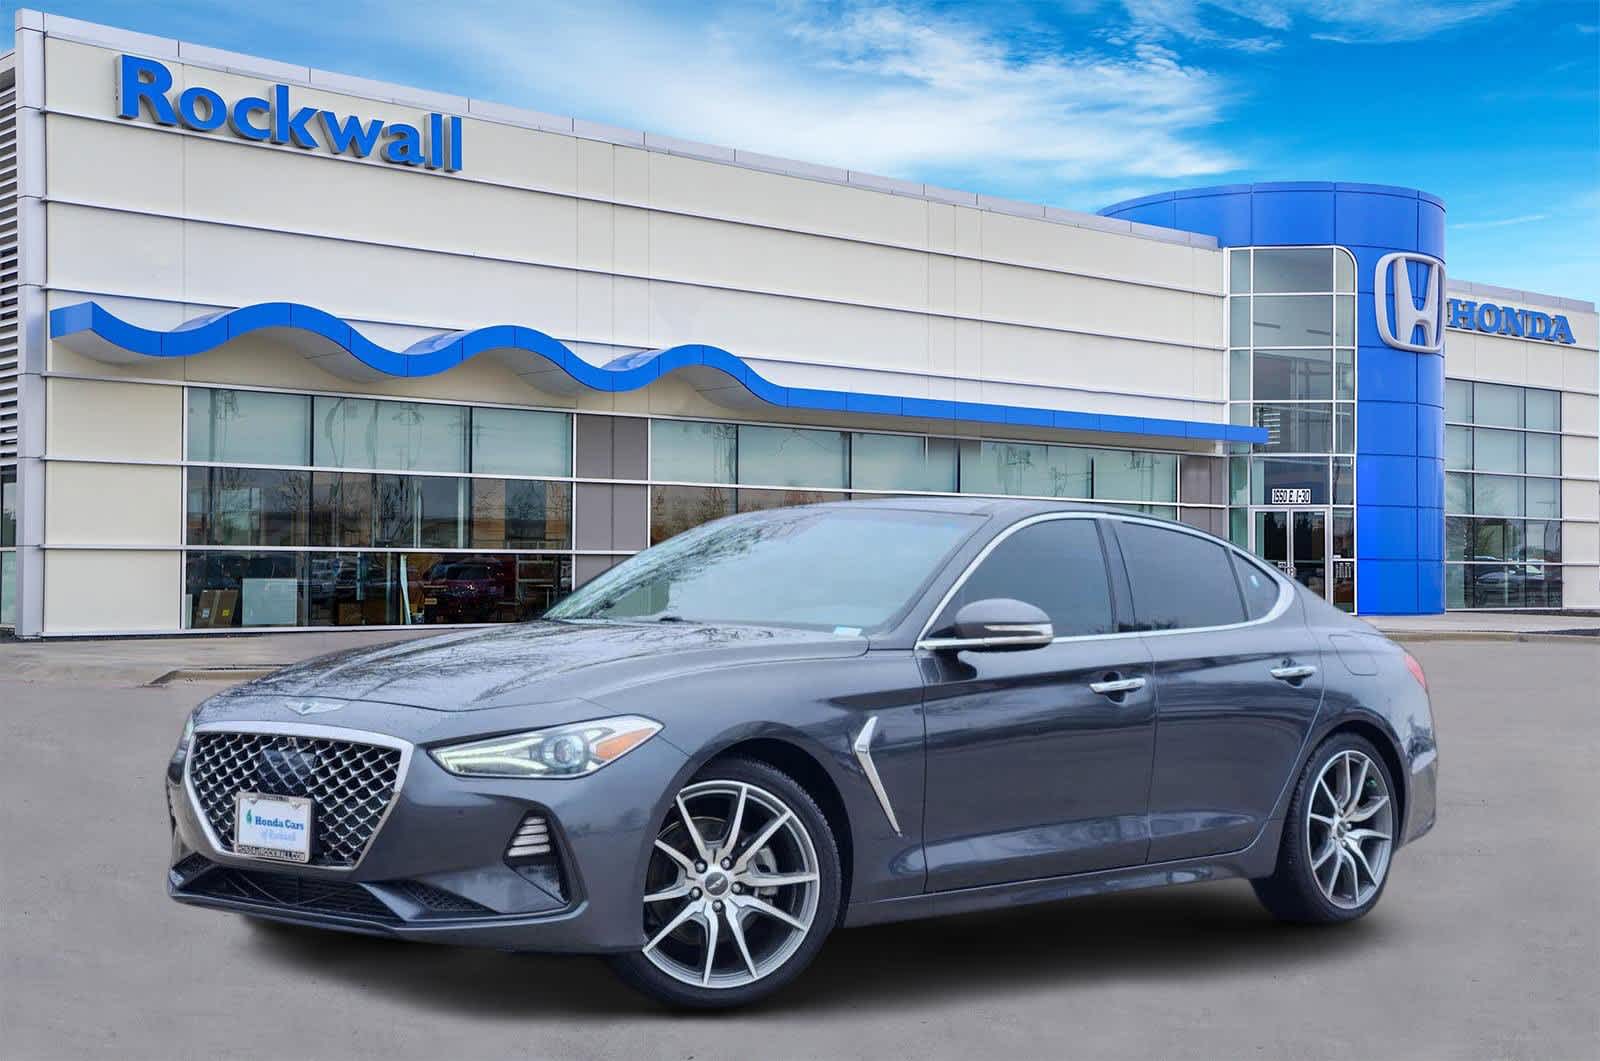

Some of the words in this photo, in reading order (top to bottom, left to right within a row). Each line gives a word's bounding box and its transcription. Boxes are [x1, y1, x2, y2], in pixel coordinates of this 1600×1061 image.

[116, 54, 463, 172] Rockwall
[1447, 298, 1576, 345] HONDA
[255, 816, 283, 828] Honda
[284, 819, 304, 830] Cars
